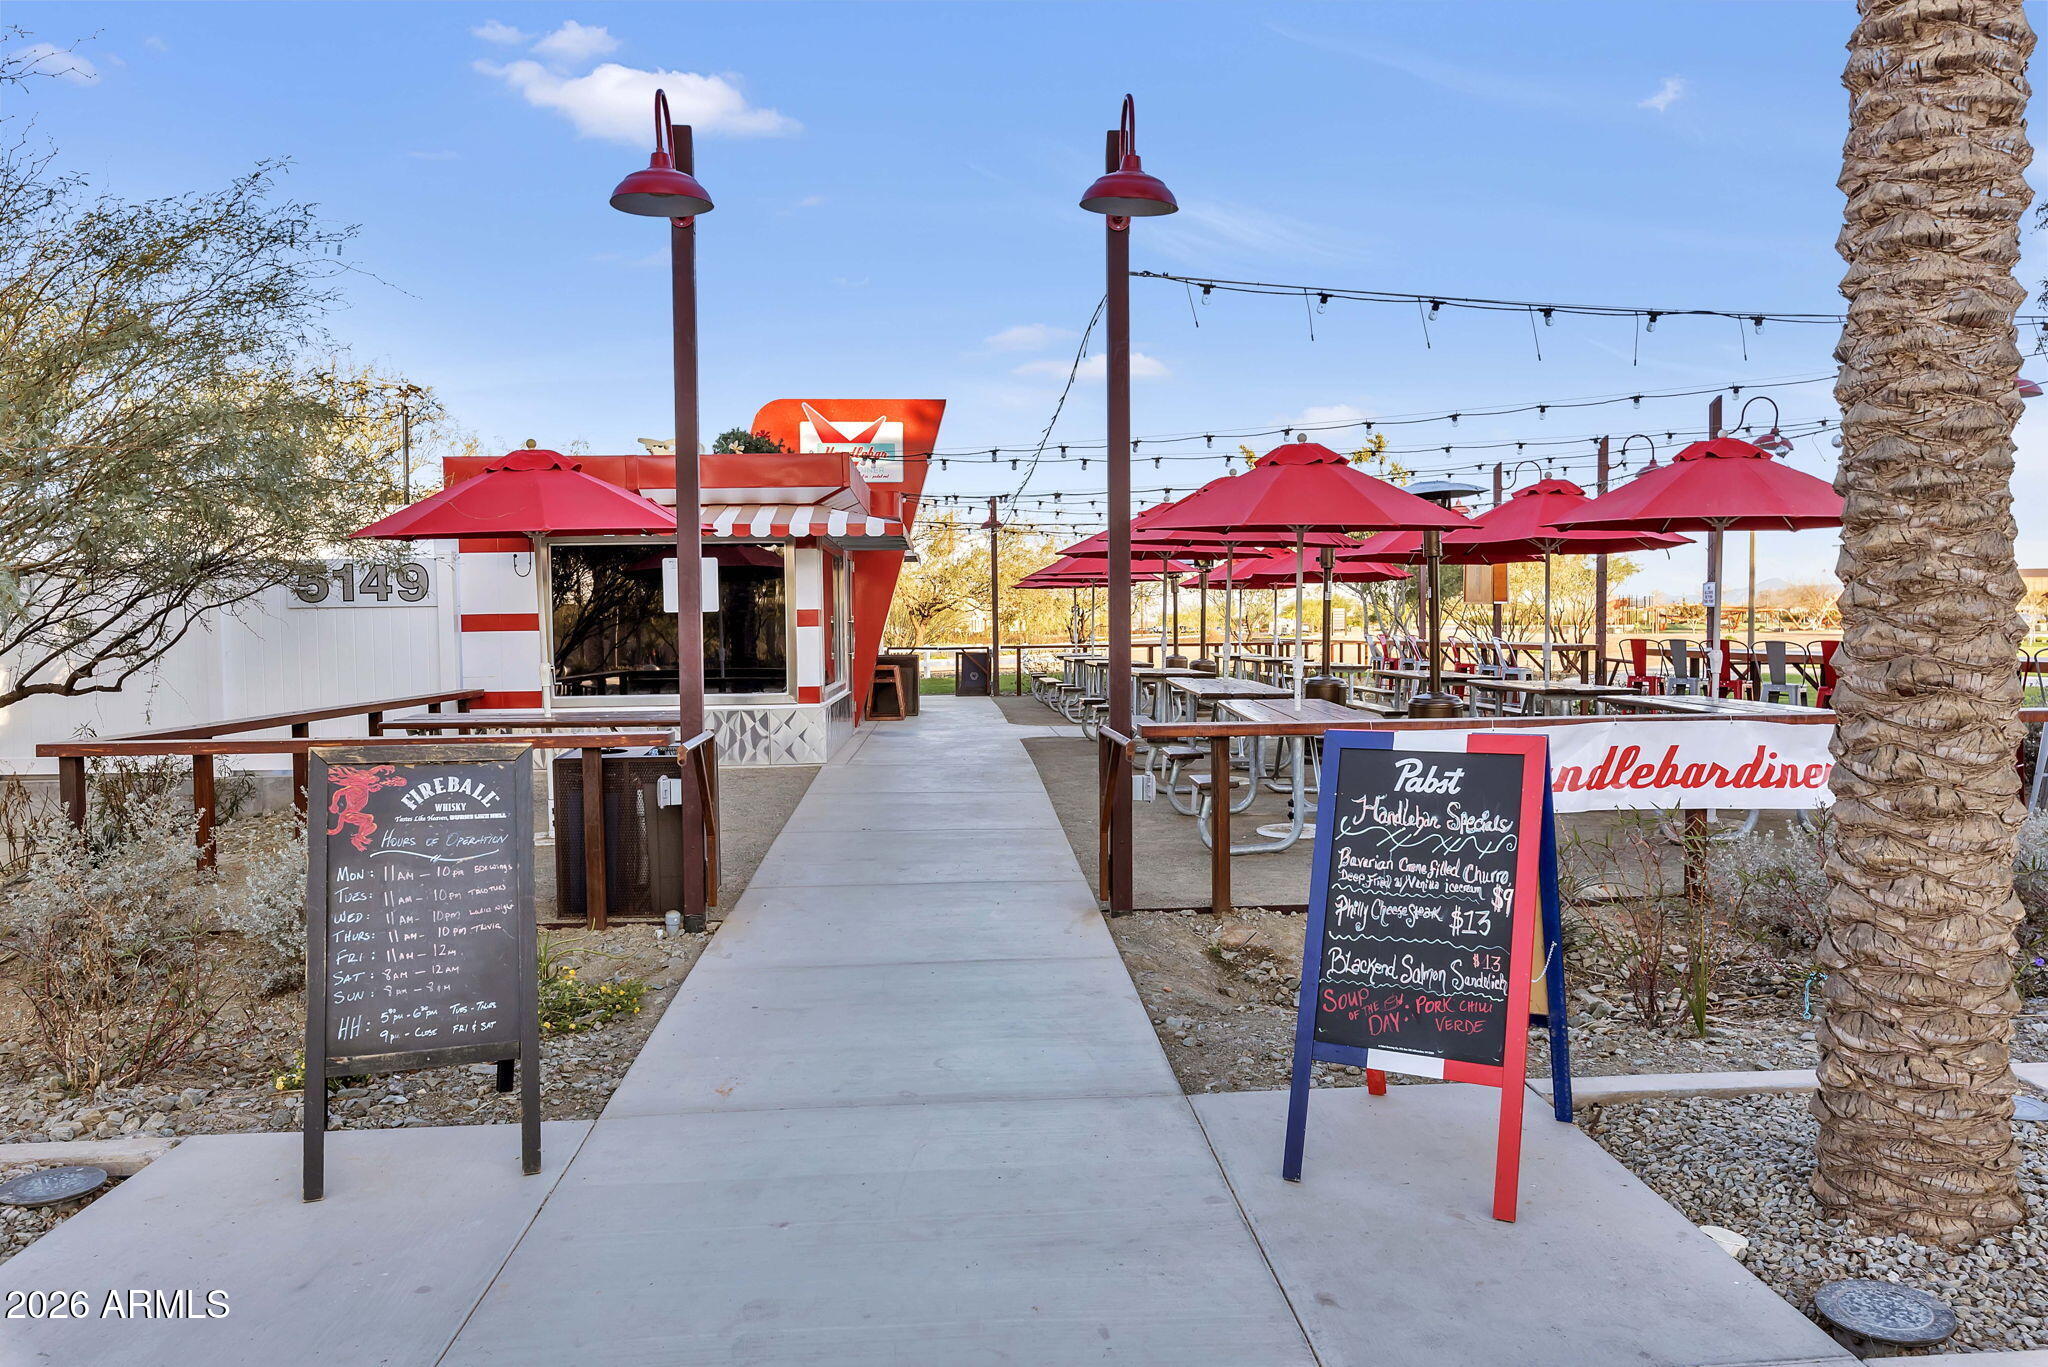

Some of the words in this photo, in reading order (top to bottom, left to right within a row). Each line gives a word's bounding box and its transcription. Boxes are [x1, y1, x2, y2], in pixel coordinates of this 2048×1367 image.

[296, 562, 430, 603] 5149
[1393, 758, 1465, 794] Pabst
[1551, 744, 1833, 792] ndlebardine
[400, 776, 501, 810] FIREBALL
[434, 803, 467, 812] WHISKY
[1351, 794, 1441, 836] Handlebar
[1447, 801, 1513, 835] Specials
[1338, 869, 1366, 882] Deep
[1335, 894, 1369, 931] Philly
[1490, 885, 1513, 917] $9
[1449, 905, 1491, 937] $13
[1472, 953, 1501, 972] $13
[1323, 987, 1370, 1013] SOUP
[1348, 1010, 1359, 1021] OF
[1362, 1001, 1379, 1016] THE
[1415, 995, 1455, 1014] PORK
[1435, 1018, 1486, 1035] VERDE
